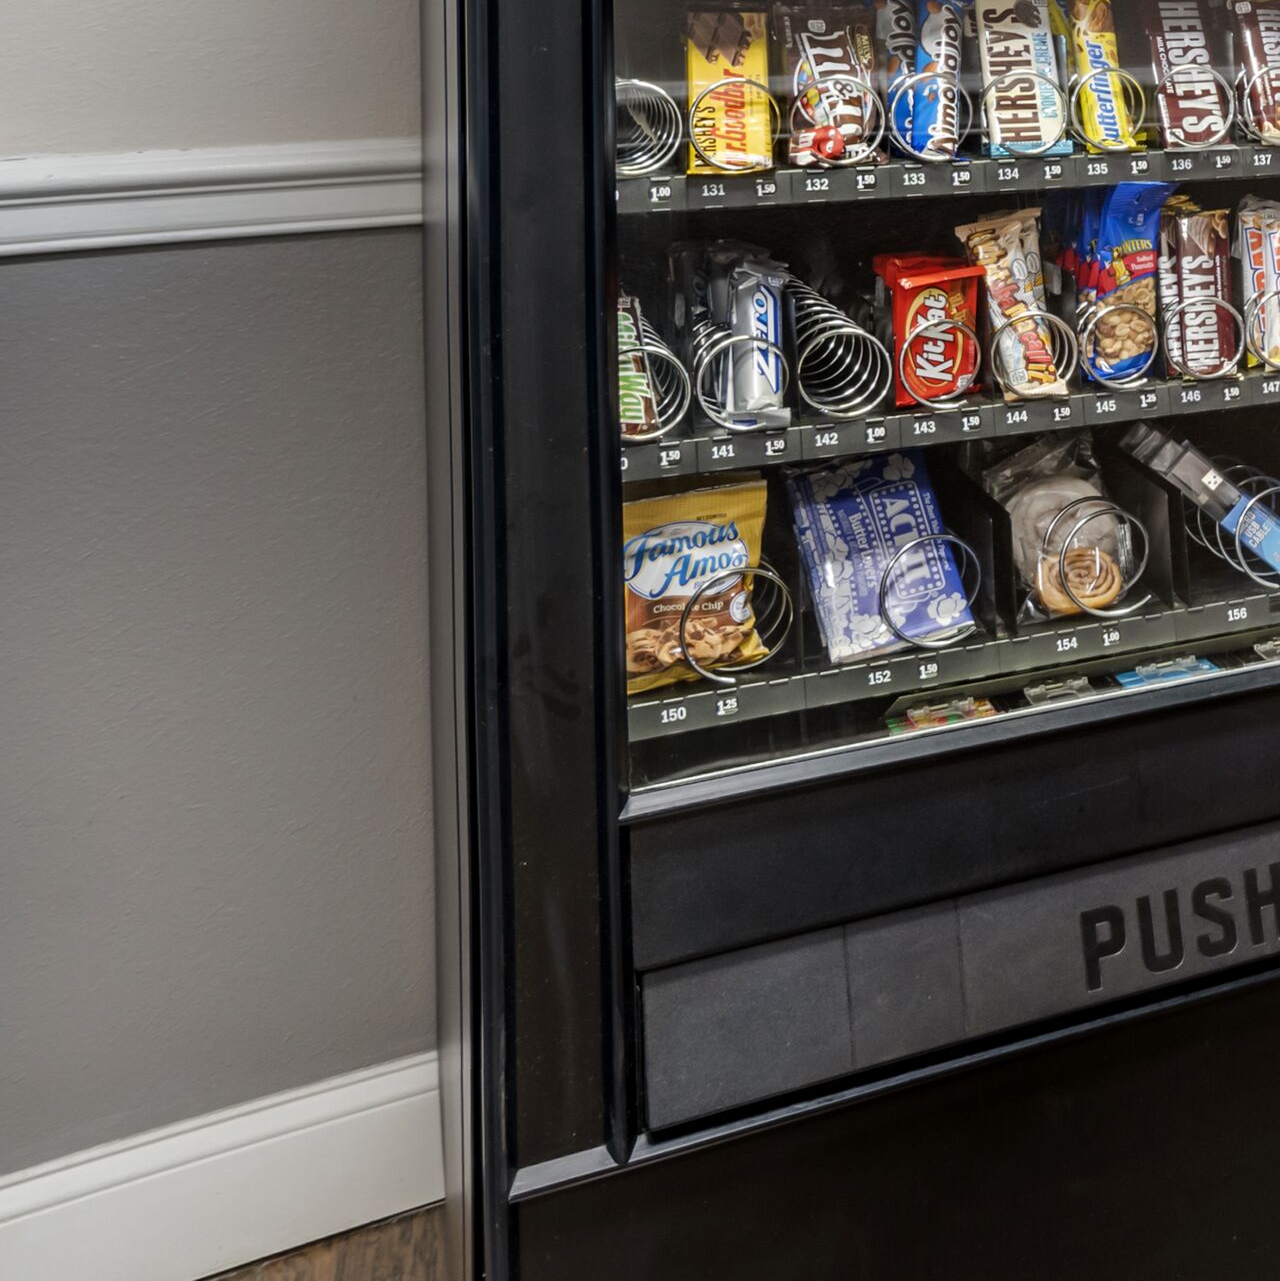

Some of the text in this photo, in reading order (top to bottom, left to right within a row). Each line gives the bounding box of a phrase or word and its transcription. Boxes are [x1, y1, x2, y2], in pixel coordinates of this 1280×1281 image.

[1156, 36, 1174, 94] MILK CHOCLATE
[1158, 1, 1225, 133] HERSHEY'S
[983, 8, 1042, 143] HERSHEY'S
[1172, 159, 1192, 170] 136
[1254, 154, 1272, 166] 137
[998, 169, 1019, 180] 134
[1088, 164, 1108, 175] 135
[805, 178, 829, 191] 132
[903, 173, 926, 186] 133
[702, 185, 725, 196] 131
[1182, 255, 1220, 370] HERSHEY'S
[1262, 382, 1280, 394] 147
[1181, 390, 1201, 403] 146
[1096, 400, 1116, 414] 145
[1006, 411, 1028, 424] 144
[914, 421, 936, 434] 143
[815, 432, 838, 446] 142
[712, 445, 735, 459] 141
[882, 498, 920, 546] ACT
[1250, 524, 1271, 548] CABLE
[624, 521, 739, 581] Famous
[849, 513, 868, 549] Butter
[860, 550, 878, 588] Lovers
[649, 551, 748, 599] Amos
[653, 601, 723, 613] Chocole Chip
[1227, 607, 1247, 621] 156
[1056, 637, 1078, 651] 154
[868, 671, 892, 685] 152
[661, 707, 687, 722] 150
